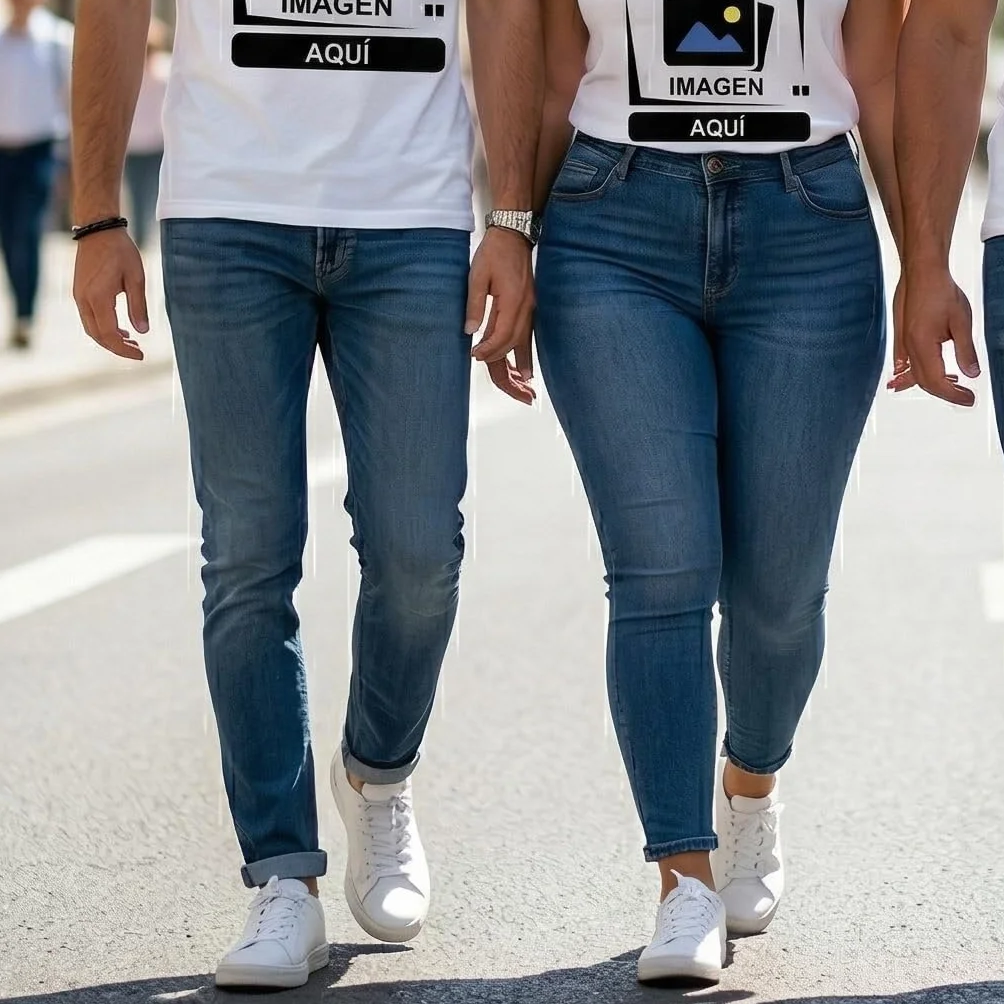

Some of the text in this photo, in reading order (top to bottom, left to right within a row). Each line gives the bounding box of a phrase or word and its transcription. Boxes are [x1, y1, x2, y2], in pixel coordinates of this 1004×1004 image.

[304, 38, 371, 66] AQUÍ
[669, 77, 764, 96] IMAGEN
[690, 114, 746, 138] AQUÍ
